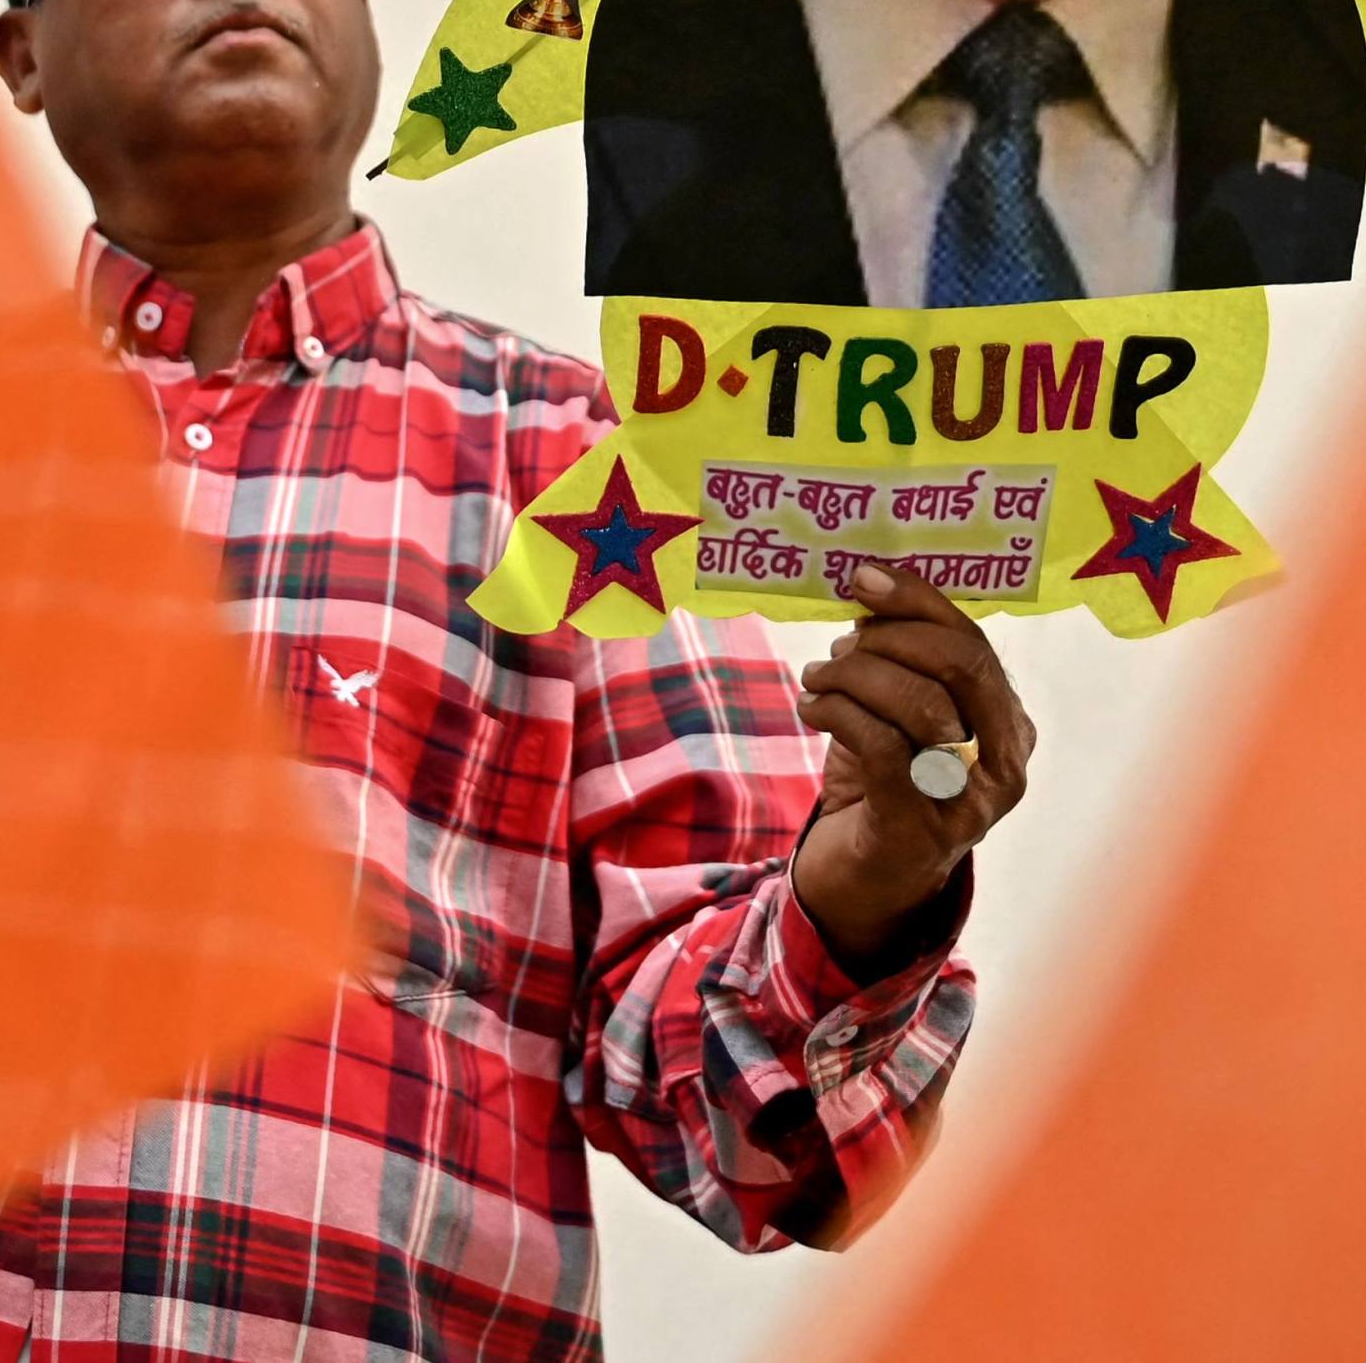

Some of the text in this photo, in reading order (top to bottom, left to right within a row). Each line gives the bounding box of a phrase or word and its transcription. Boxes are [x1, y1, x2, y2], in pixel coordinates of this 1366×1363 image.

[706, 467, 1049, 531] बहुत-बहुत बधाई एवं
[696, 528, 809, 580] हार्दिक
